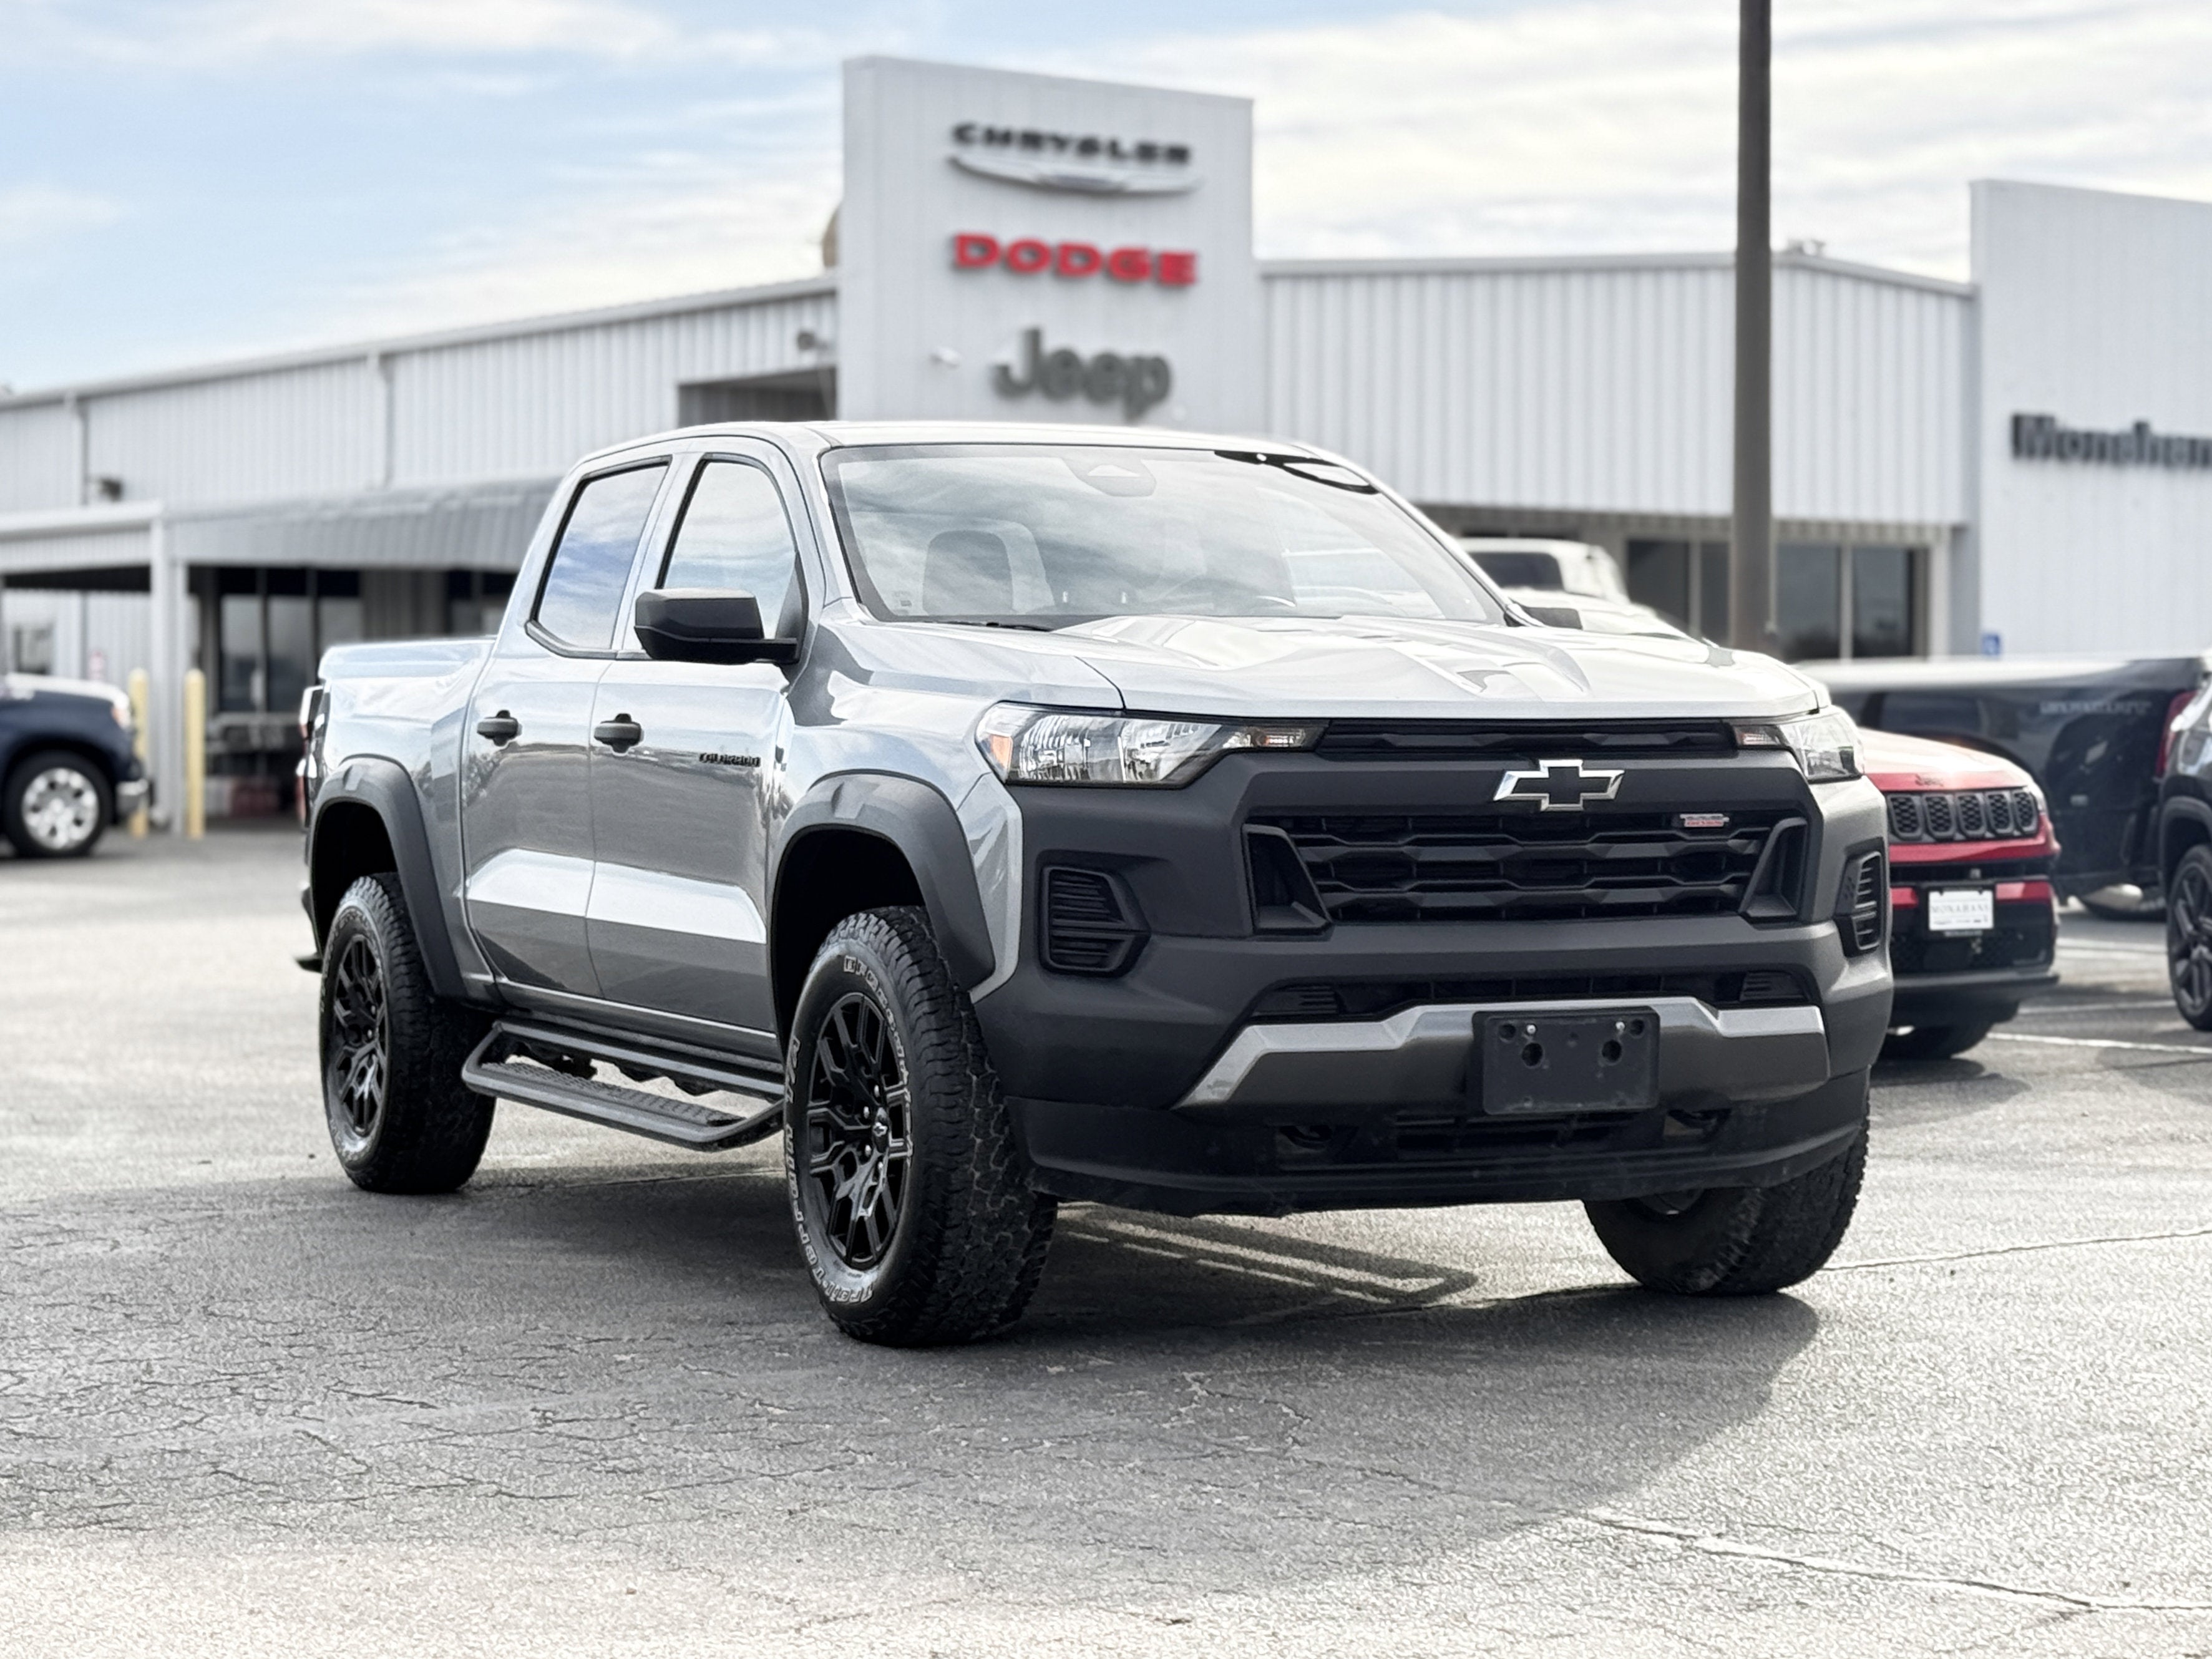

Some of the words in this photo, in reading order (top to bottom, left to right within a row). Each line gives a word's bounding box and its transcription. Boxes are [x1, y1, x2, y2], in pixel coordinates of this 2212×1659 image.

[952, 123, 1192, 165] CHRYSLER
[953, 231, 1198, 286] DODGE
[990, 326, 1172, 424] Jeep
